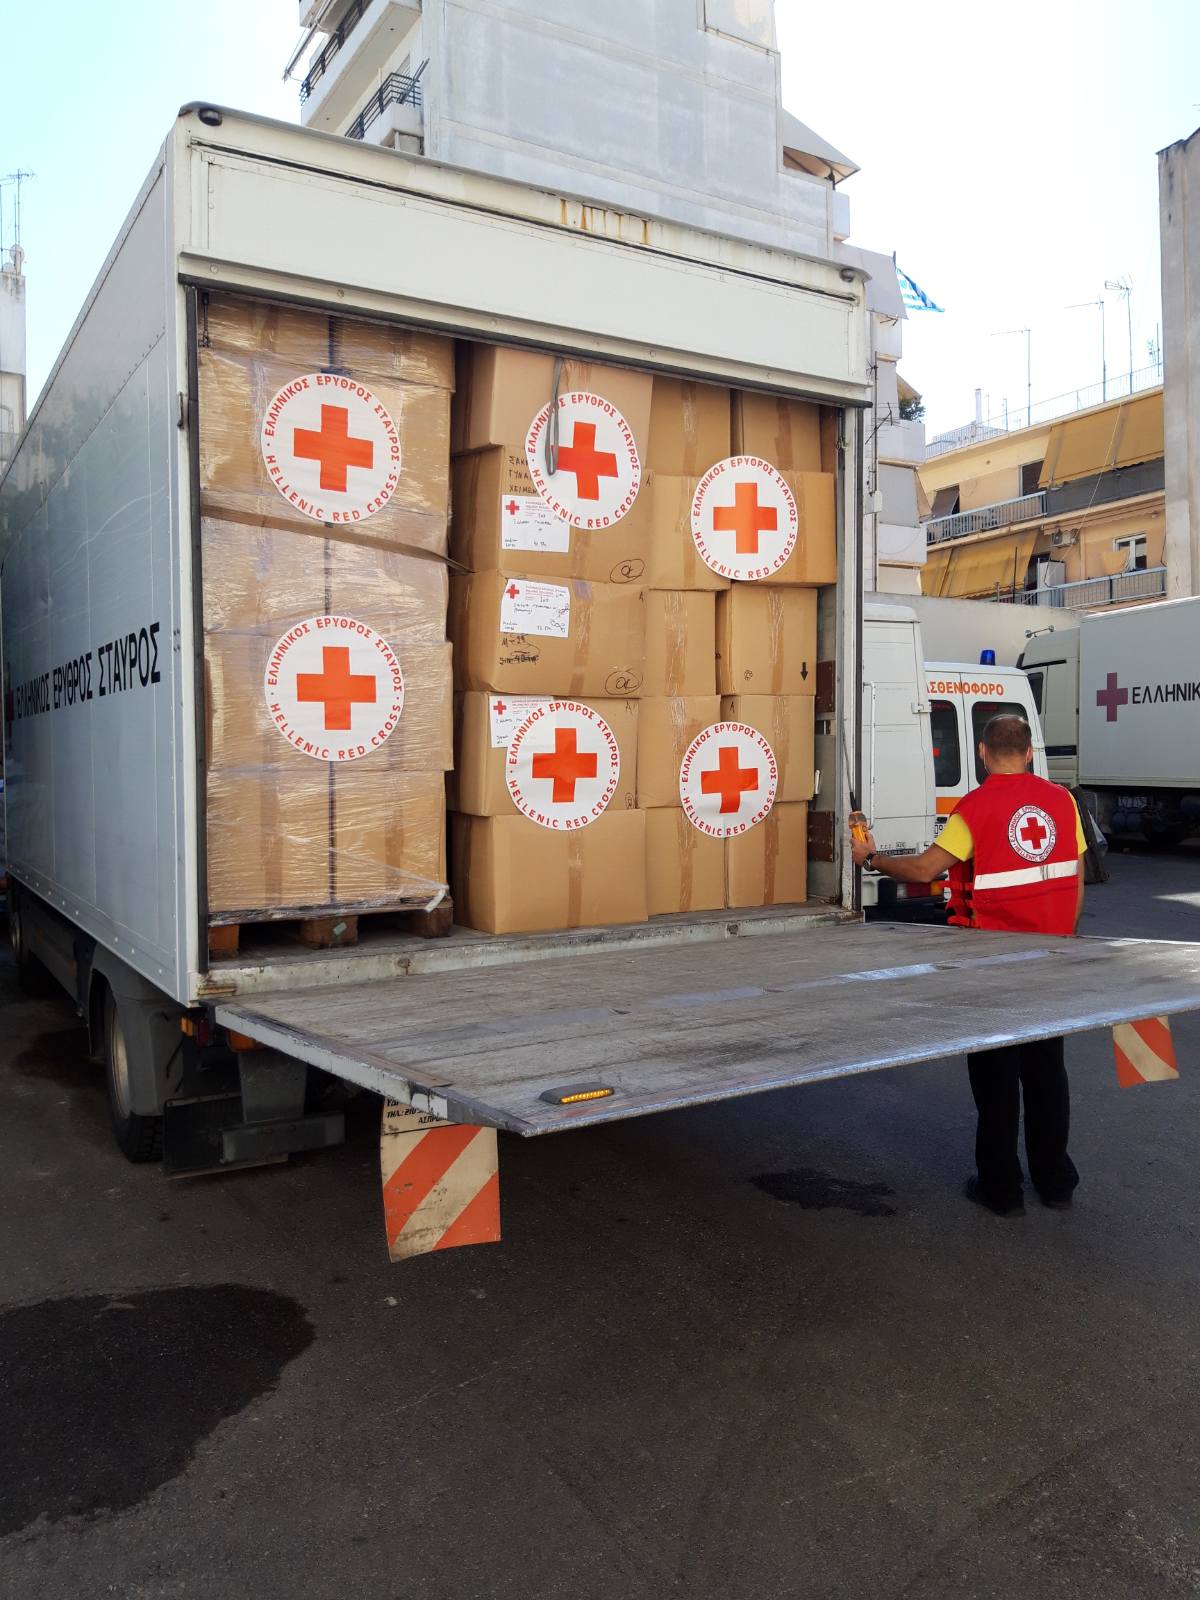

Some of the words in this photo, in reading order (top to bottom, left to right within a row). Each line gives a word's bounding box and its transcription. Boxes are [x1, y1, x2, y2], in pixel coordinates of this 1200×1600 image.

[265, 379, 309, 436] ΕΛΛΗΝΙΚΟΣ
[317, 376, 372, 402] ΕΡΥΘΡΟΣ
[375, 405, 399, 461] ΣΤΑΥΡΟΣ
[528, 398, 566, 453] ΕΛΛΗΝΙΣ
[572, 395, 616, 417] ΕΡΥΘΡΟΣ
[618, 419, 639, 470] ΣΤΑΥΡΟΣ
[266, 456, 323, 518] HELLENIC
[333, 511, 360, 521] RED
[367, 474, 396, 512] CROSS
[532, 470, 580, 525] HELLENIC
[588, 519, 609, 527] RED
[615, 483, 638, 518] CROSS
[694, 464, 725, 516] ΕΛΛΗΝΙΚΟΣ
[731, 458, 774, 475] ΕΡΥΘΡΟΣ
[776, 477, 796, 522] ΣΤΑΥΡΟΣ
[695, 532, 740, 577] HELLENIC
[748, 568, 769, 578] RED
[774, 533, 795, 568] CROSS
[53, 652, 92, 709] ΕΡΥΘΡΟΣ
[98, 622, 160, 696] ΣΤΑΥΡΟΣ
[268, 624, 310, 685] ΕΛΛΗΝΙΚΟΣ
[316, 618, 372, 638] ΕΡΥΘΡΟΣ
[376, 639, 401, 691] ΣΤΑΥΡΟΣ
[271, 704, 329, 758] HELLENIC
[339, 746, 364, 759] RED
[372, 705, 400, 745] CROSS
[509, 708, 544, 764] ΕΛΛΗΝΙΚΟΣ
[549, 703, 594, 719] ΕΡΥΘΡΟΣ
[597, 720, 618, 767] ΣΤΑΥΡΟΣ
[682, 731, 710, 782] ΕΛΛΗΝΙΚΟΣ
[715, 724, 756, 738] ΕΡΥΘΡΟΣ
[758, 738, 776, 779] ΣΤΑΥΡΟΣ
[509, 780, 558, 827] HELLENIC
[566, 816, 588, 828] RED
[592, 779, 616, 815] CROSS
[683, 797, 721, 835] HELLENIC
[727, 824, 745, 835] RED
[752, 791, 774, 823] CROSS
